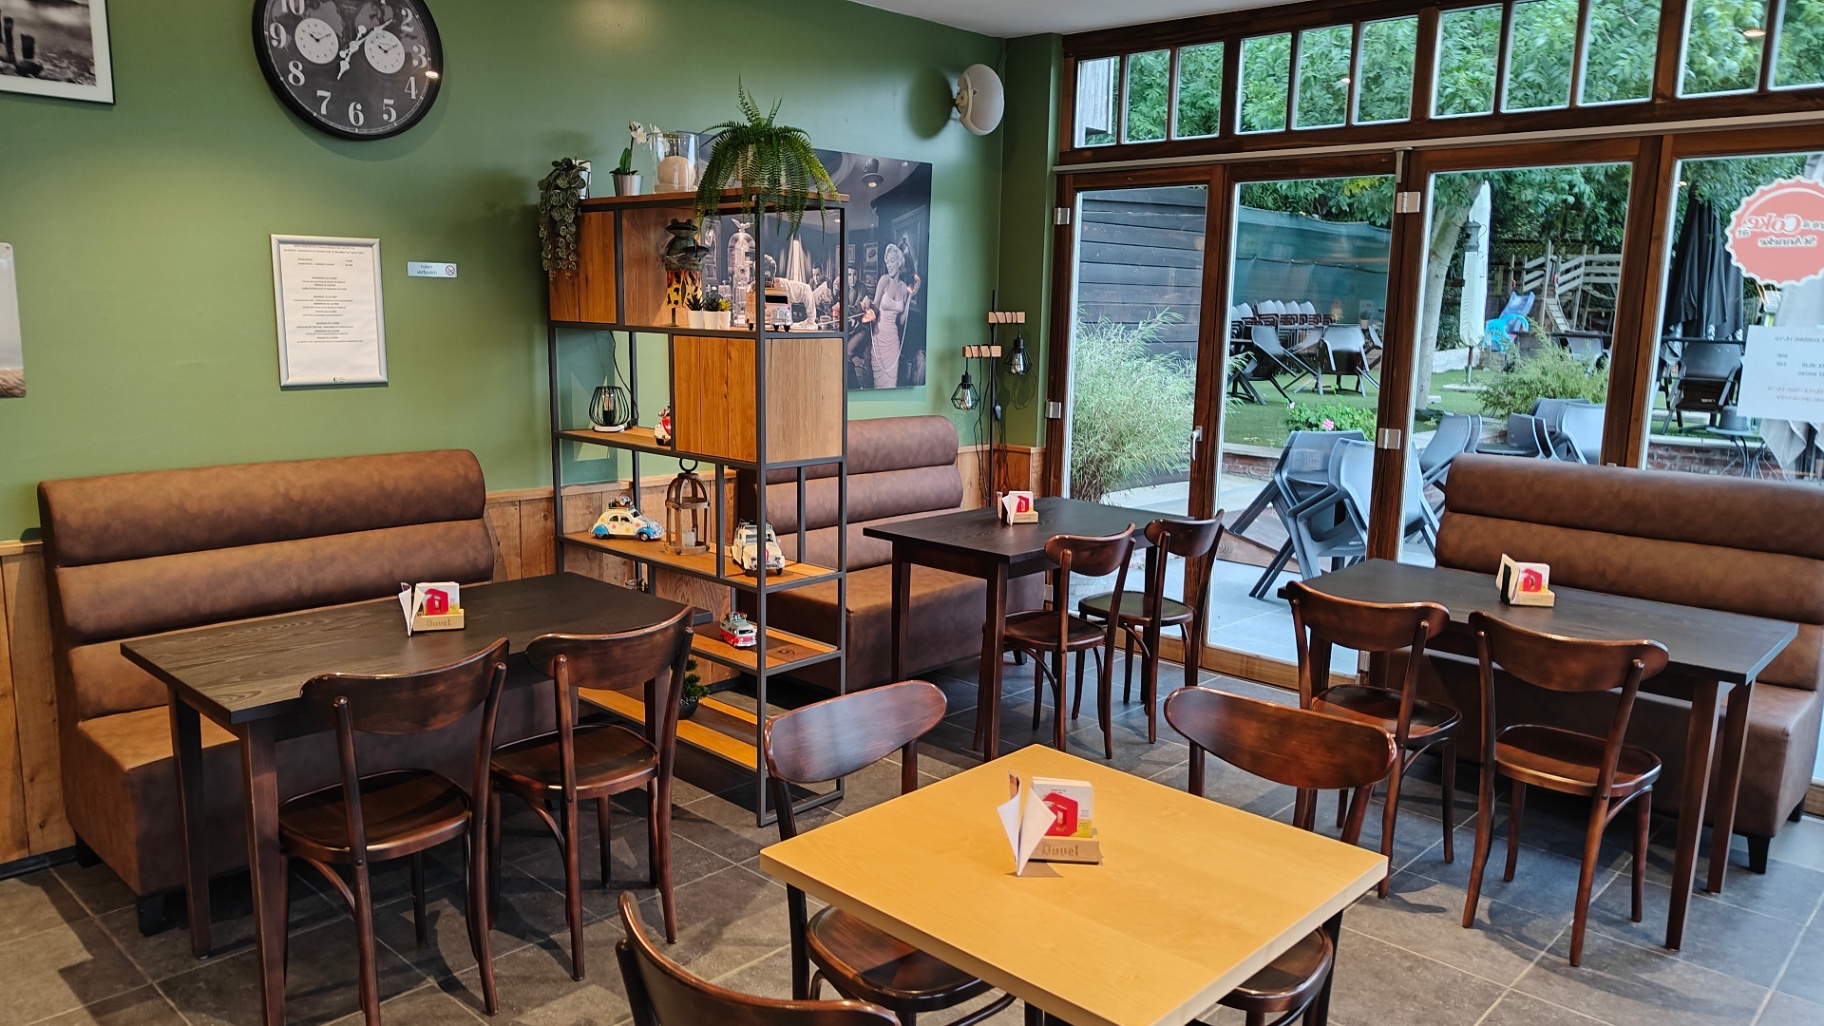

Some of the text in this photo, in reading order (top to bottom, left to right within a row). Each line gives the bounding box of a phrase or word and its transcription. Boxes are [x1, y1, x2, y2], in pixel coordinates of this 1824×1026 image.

[401, 7, 413, 32] 2
[269, 22, 287, 49] 9
[412, 44, 428, 68] 3
[288, 60, 305, 86] 8
[404, 76, 418, 100] 4
[316, 90, 331, 115] 7
[348, 101, 364, 127] 6
[382, 98, 397, 123] 5
[1041, 844, 1079, 857] Duvel
